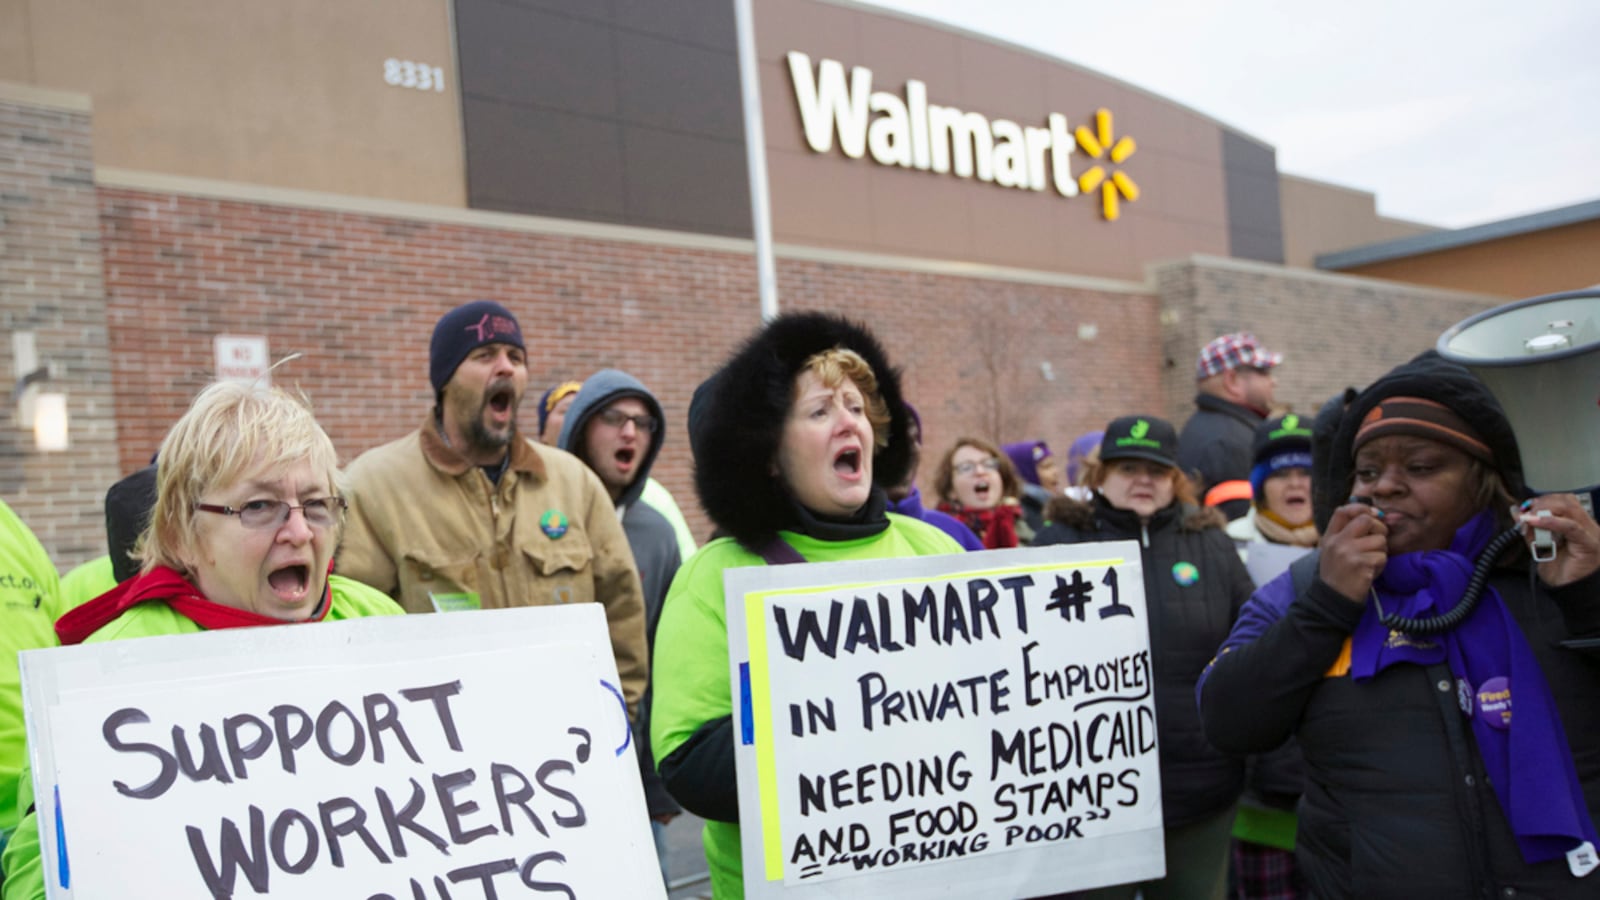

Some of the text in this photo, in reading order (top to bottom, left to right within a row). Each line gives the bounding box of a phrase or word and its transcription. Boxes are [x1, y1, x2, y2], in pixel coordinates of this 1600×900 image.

[384, 58, 444, 93] 8331
[787, 50, 1079, 197] Walmart
[773, 566, 1134, 662] WALMART #1
[789, 641, 1151, 738] IN PRIVATE EMPLOYEES
[102, 679, 463, 800] SUPPORT
[799, 705, 1156, 817] NEEDING MEDICAID
[791, 769, 1140, 863] AND FOOD STAMPS
